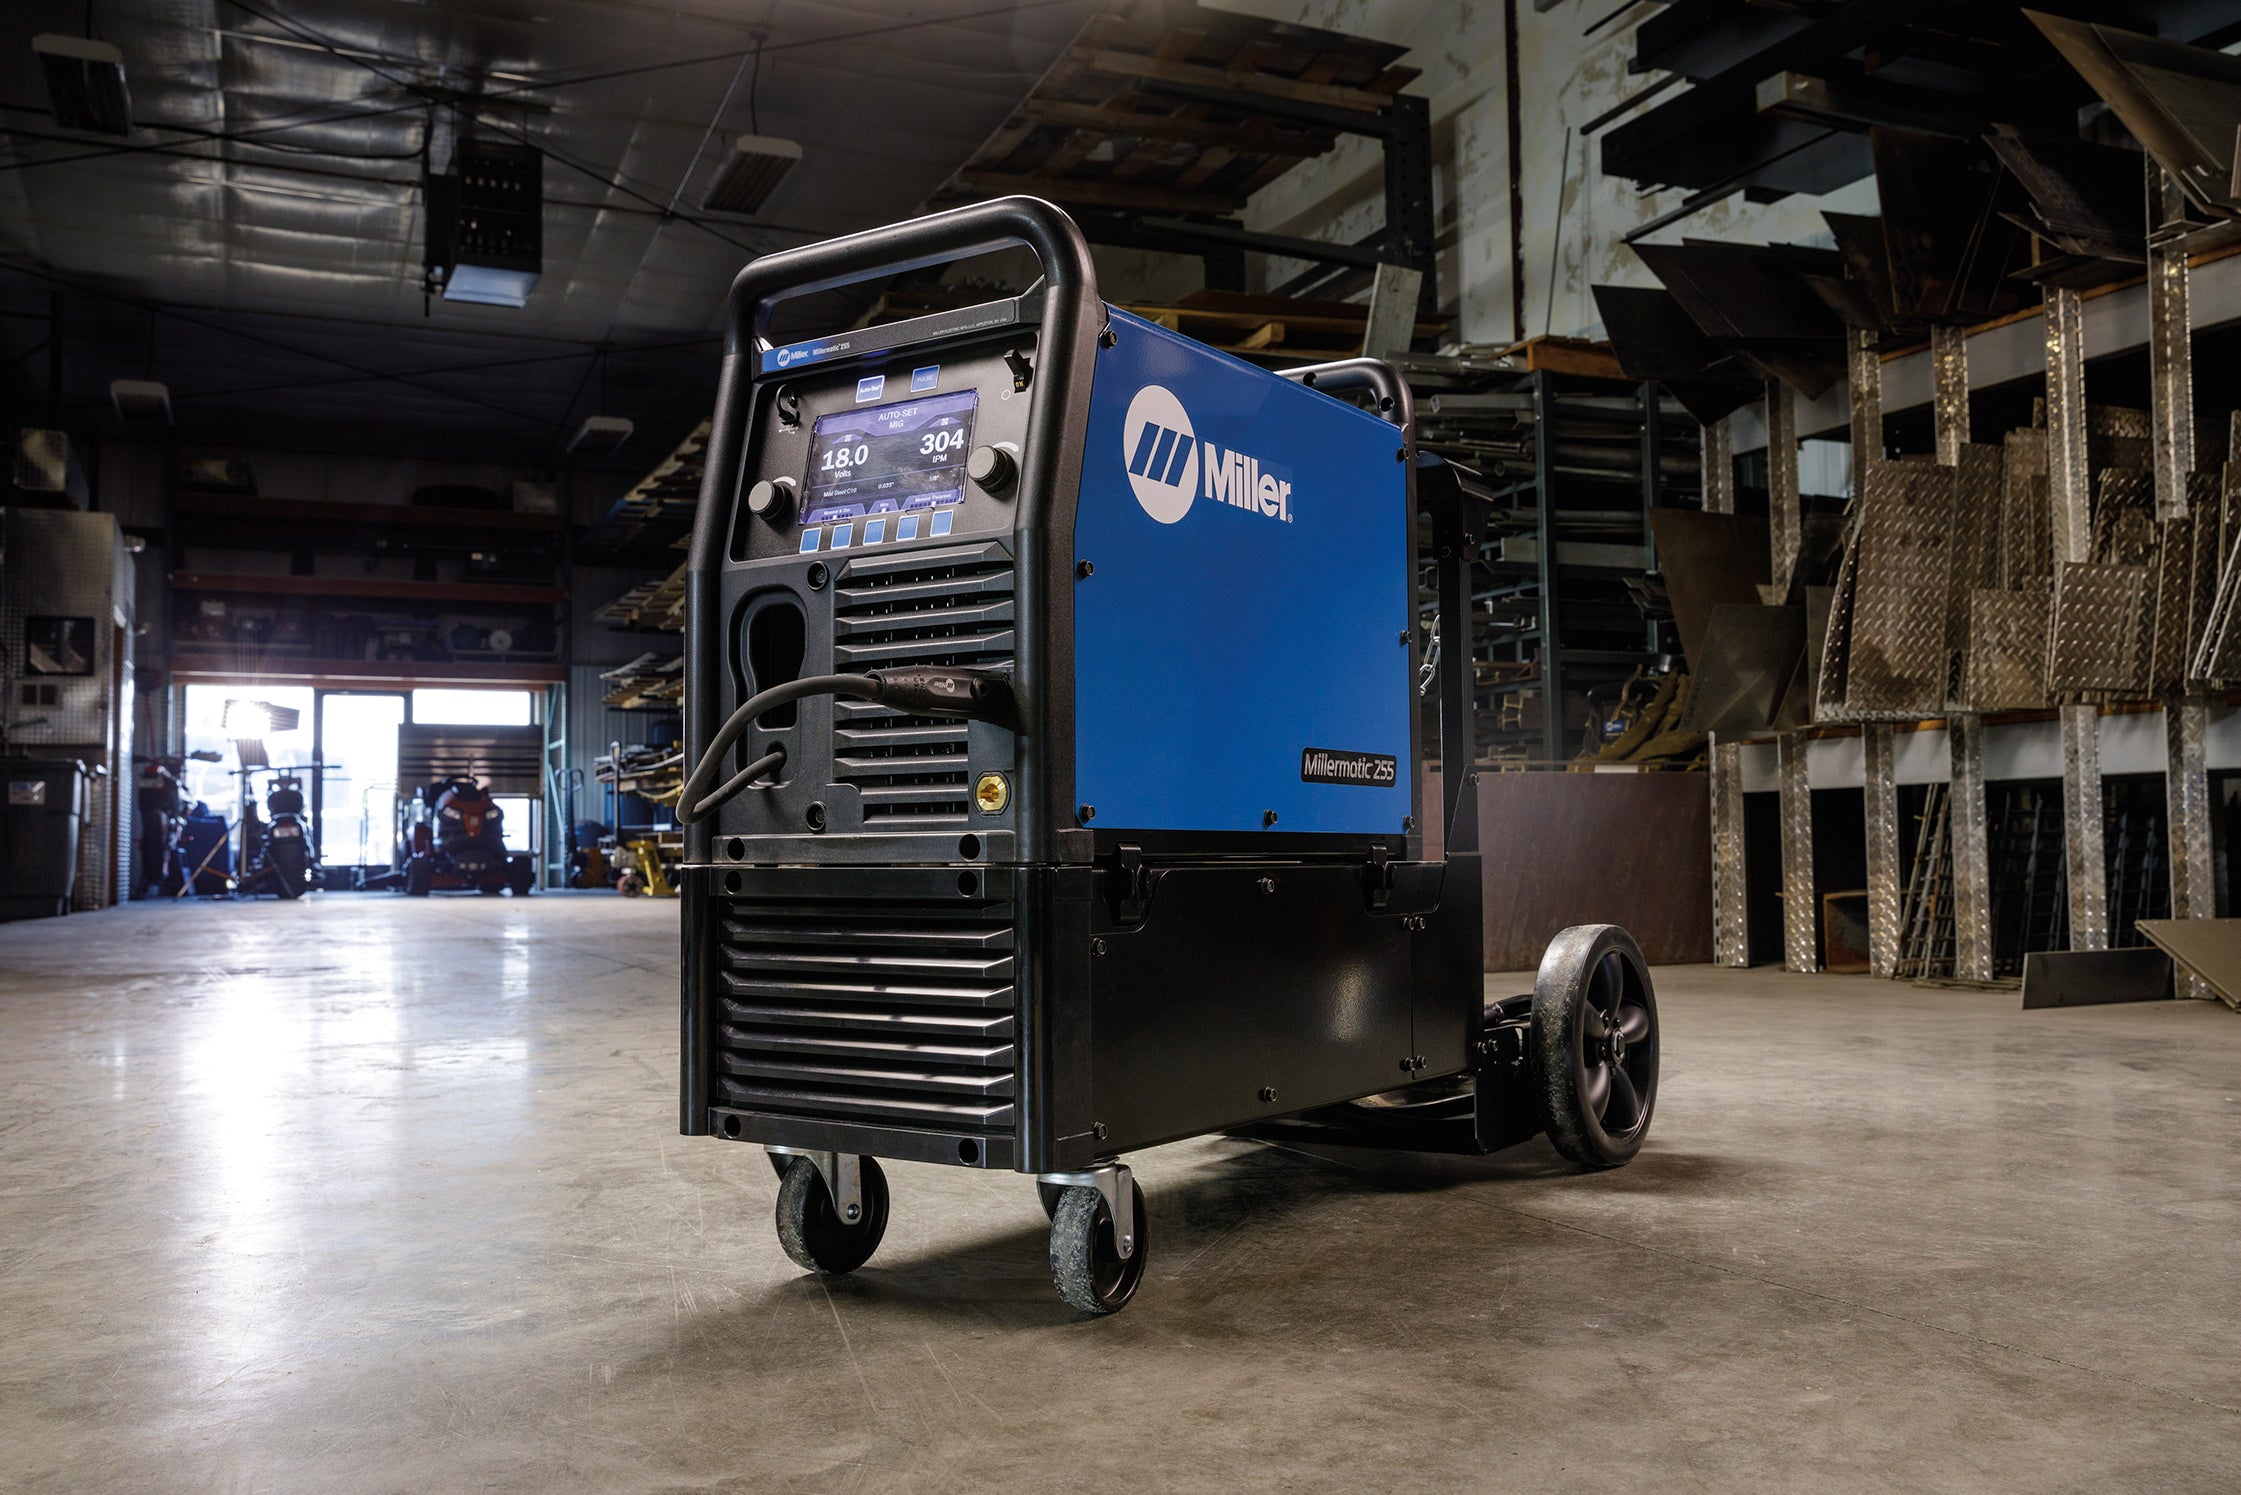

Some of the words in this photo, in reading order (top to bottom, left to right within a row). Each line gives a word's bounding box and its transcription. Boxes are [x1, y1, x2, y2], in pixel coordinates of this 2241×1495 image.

[917, 374, 934, 383] PULSE
[878, 407, 918, 421] AUTO-SET
[888, 419, 904, 430] MIG
[919, 428, 964, 455] 304
[821, 444, 869, 471] 18.0
[932, 453, 947, 464] IPM
[834, 469, 851, 479] Volts
[1304, 752, 1374, 779] Millermatic
[1373, 759, 1395, 781] 255
